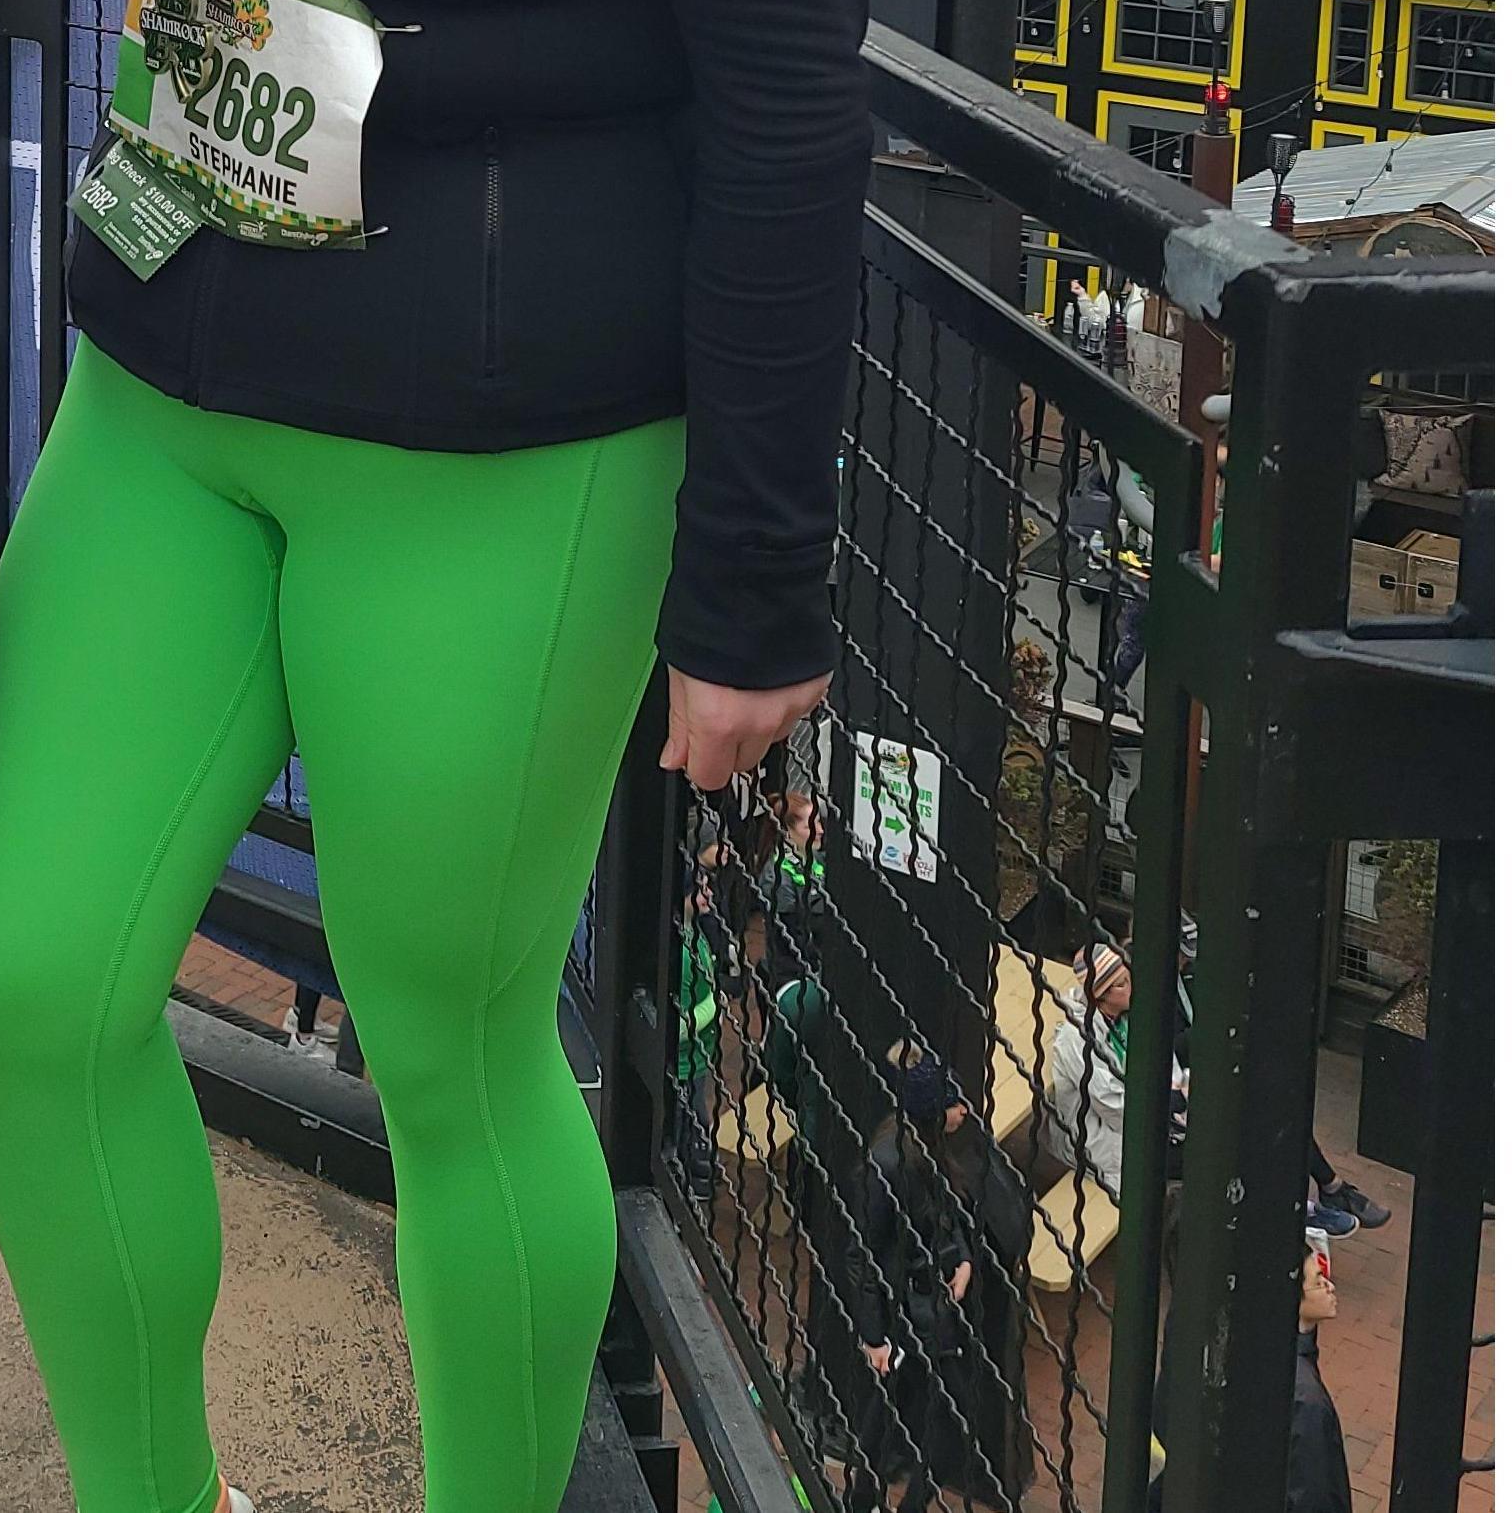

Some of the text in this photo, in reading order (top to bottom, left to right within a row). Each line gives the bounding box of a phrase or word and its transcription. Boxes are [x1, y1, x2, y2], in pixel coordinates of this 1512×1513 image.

[141, 9, 206, 48] SHAMROCK
[184, 45, 316, 174] 2682
[118, 159, 148, 188] Check
[189, 131, 297, 206] STEPHANIE
[81, 180, 119, 217] 2682
[171, 209, 196, 231] OFF
